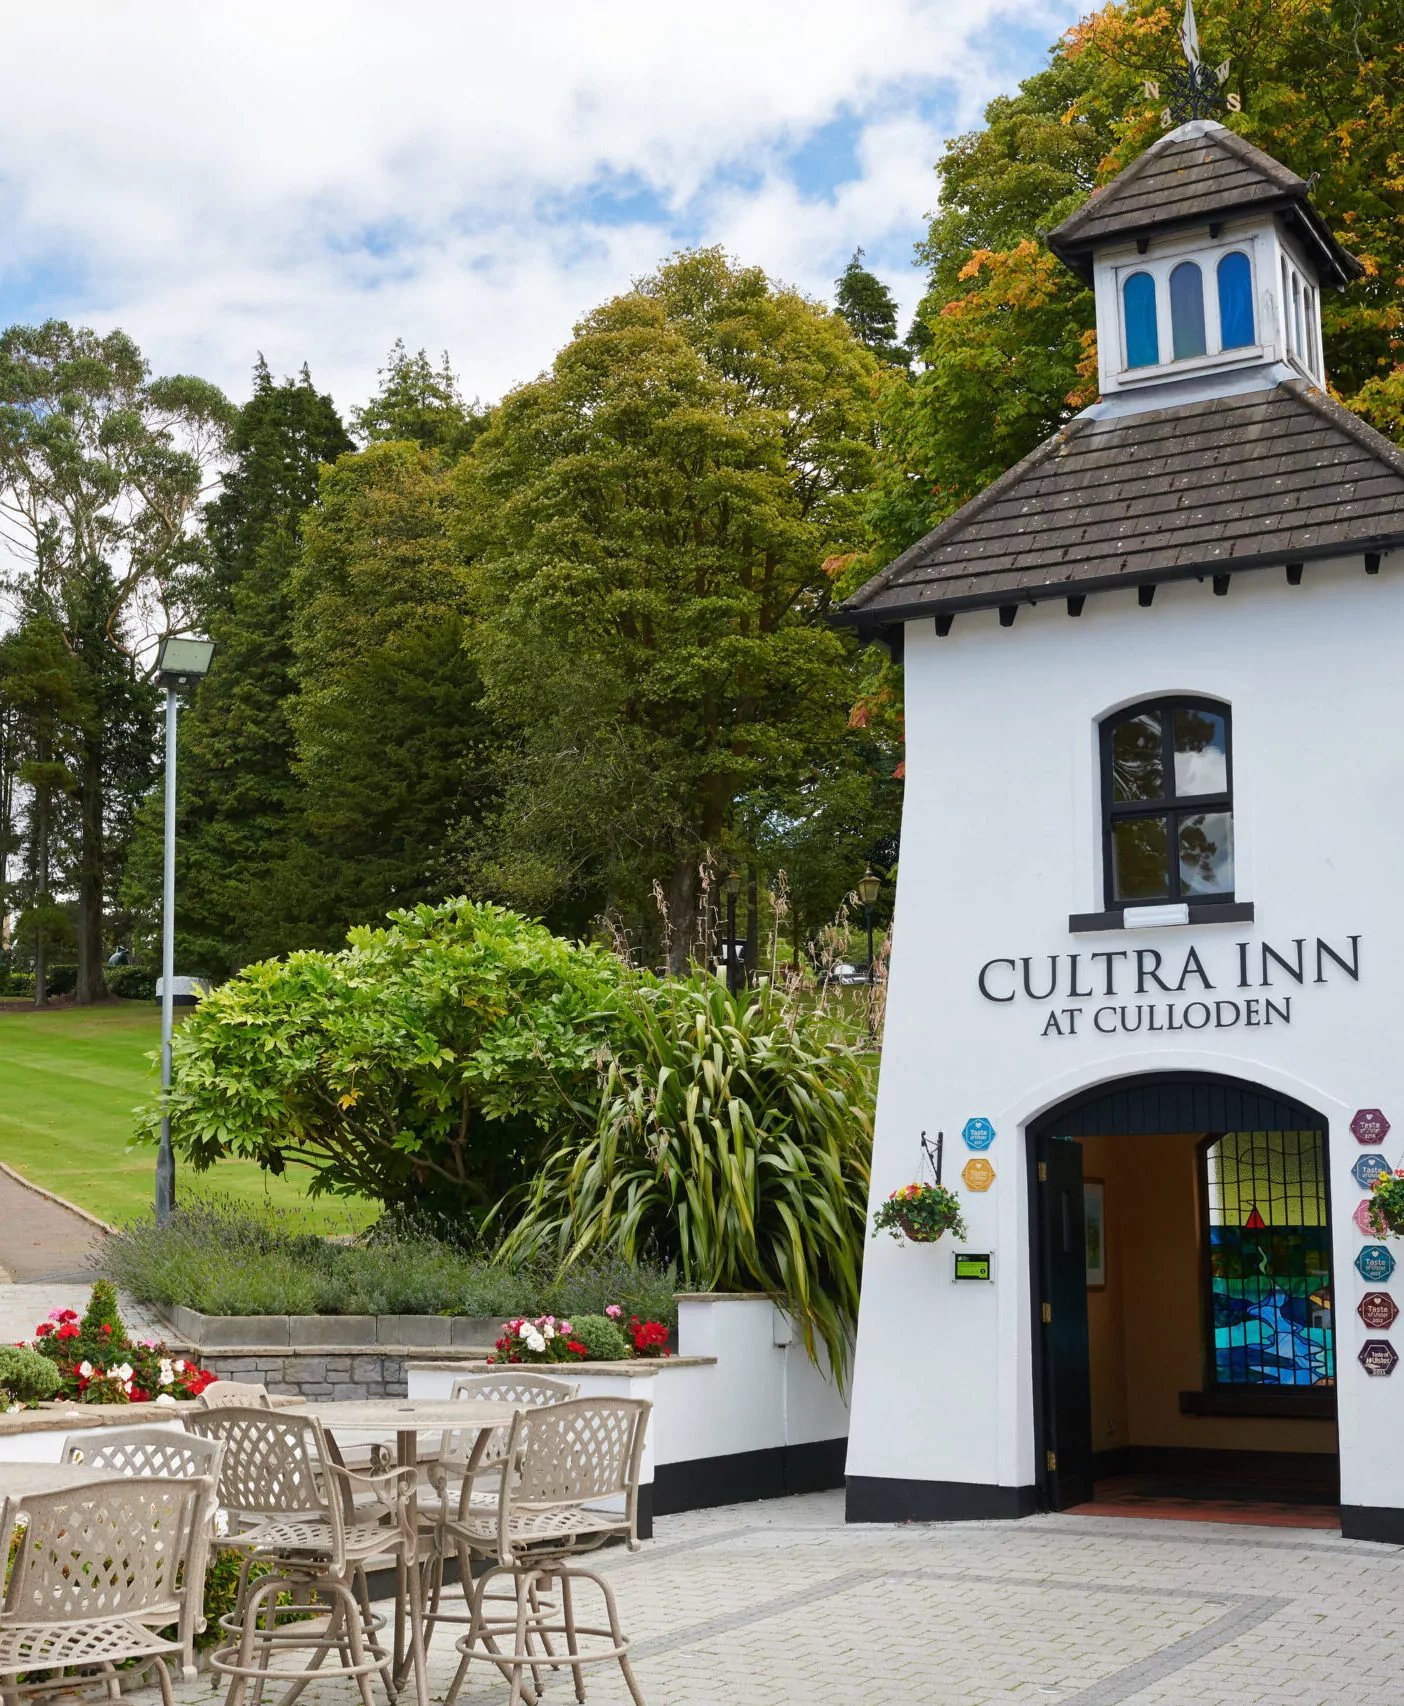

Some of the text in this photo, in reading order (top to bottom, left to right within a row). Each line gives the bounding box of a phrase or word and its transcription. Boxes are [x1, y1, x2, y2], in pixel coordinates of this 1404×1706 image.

[1142, 80, 1160, 99] N
[1226, 93, 1241, 112] S
[978, 935, 1363, 1003] CULTRA INN
[1040, 996, 1293, 1037] AT CULLODEN
